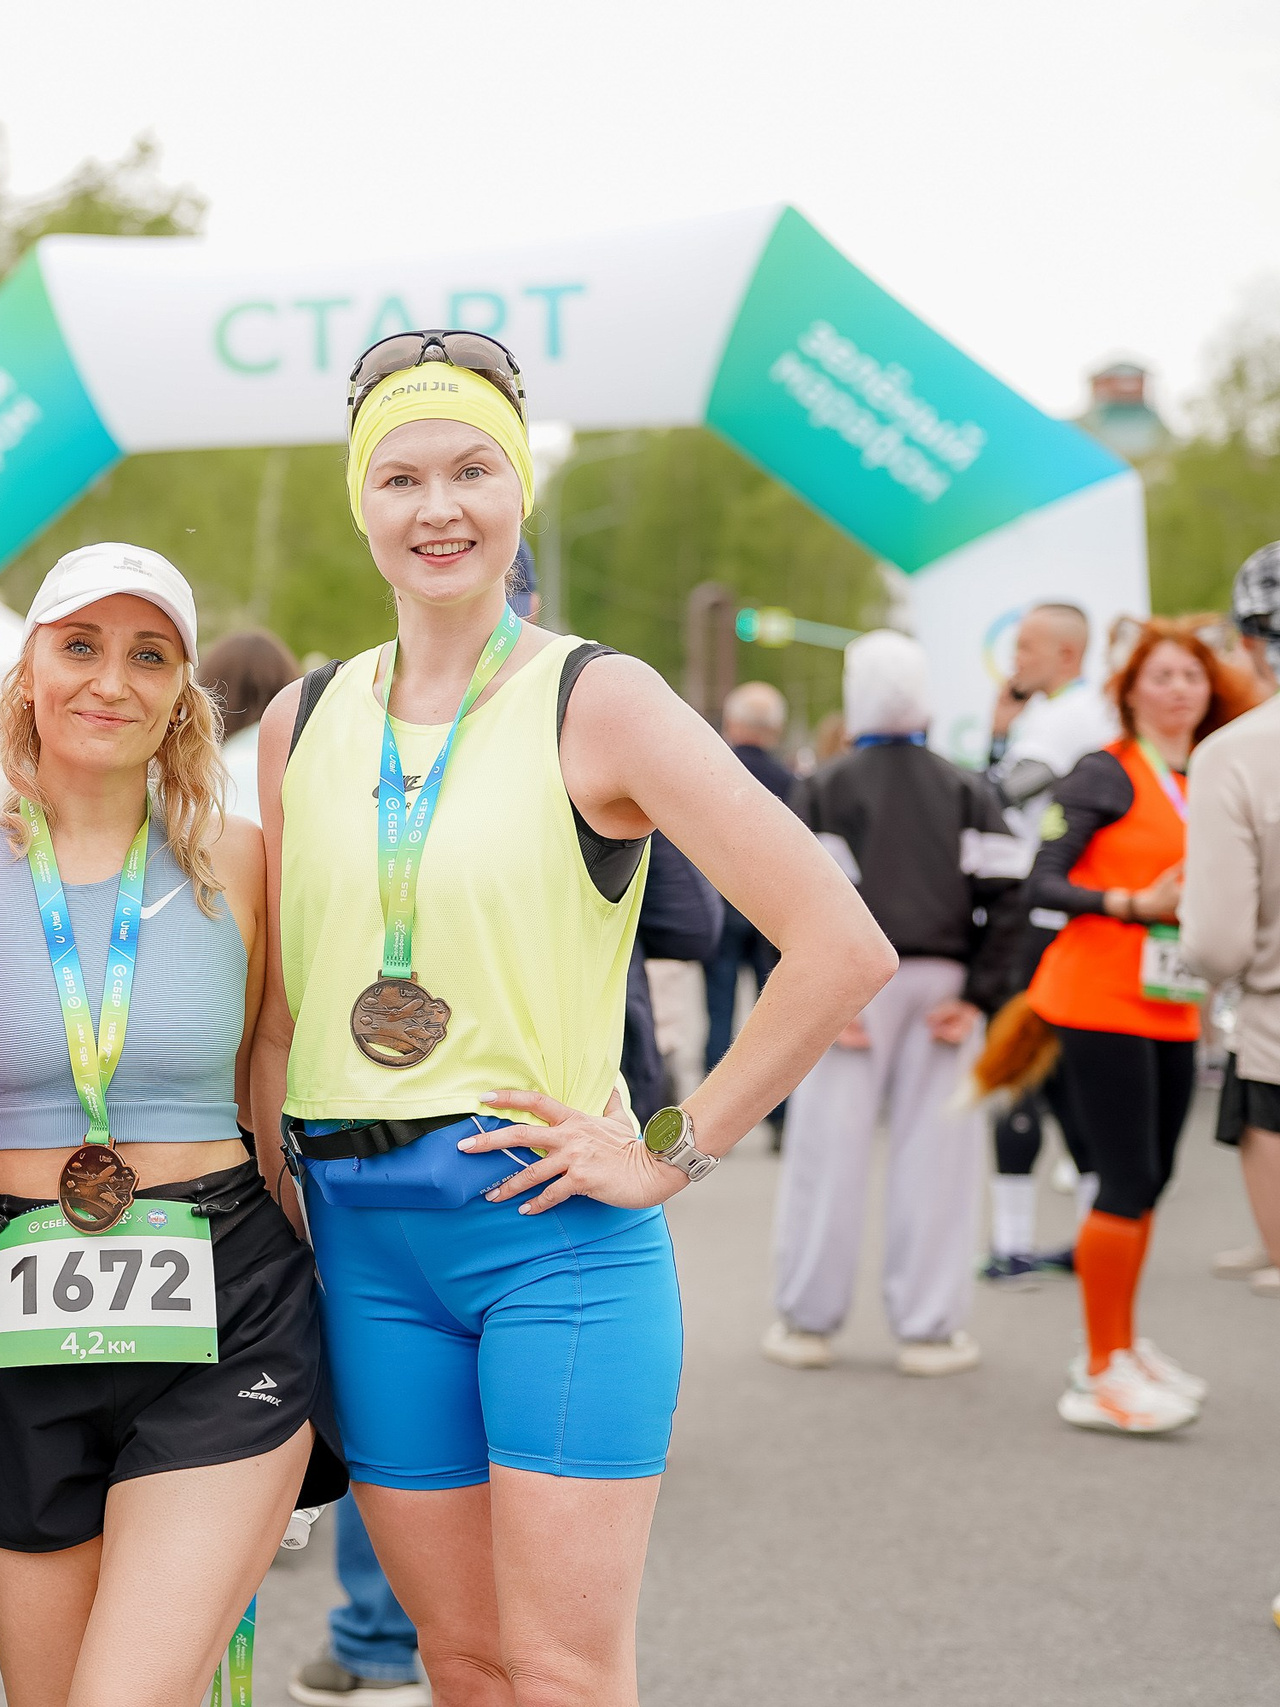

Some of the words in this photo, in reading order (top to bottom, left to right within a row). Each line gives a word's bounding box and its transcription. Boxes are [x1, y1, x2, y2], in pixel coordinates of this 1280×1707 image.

[213, 283, 585, 375] СТАРТ
[414, 797, 429, 828] СБЕР
[31, 820, 40, 837] 185
[387, 812, 398, 844] СБЕР
[400, 881, 408, 902] 185
[51, 910, 62, 931] Utair
[119, 920, 131, 941] Utair
[63, 966, 76, 994] СБЕР
[113, 979, 123, 1008] СБЕР
[76, 1023, 85, 1043] лет
[107, 1022, 117, 1041] 185
[79, 1046, 88, 1067] 185
[10, 1249, 192, 1315] 1672
[236, 1388, 283, 1407] DEMIX
